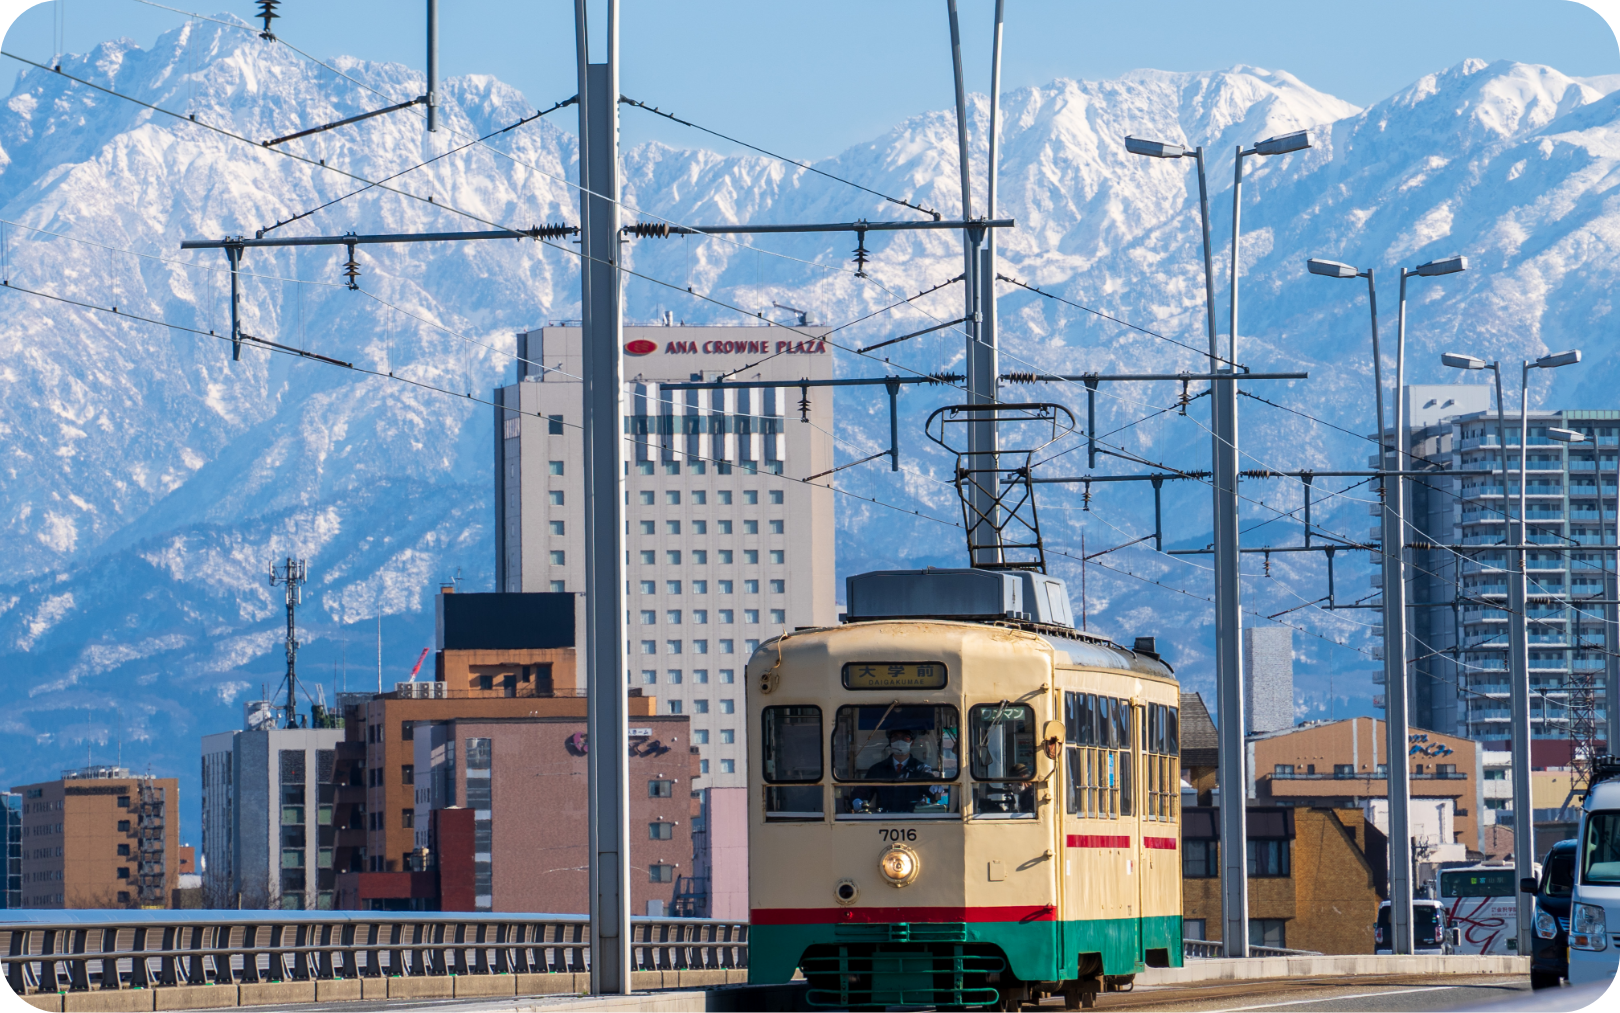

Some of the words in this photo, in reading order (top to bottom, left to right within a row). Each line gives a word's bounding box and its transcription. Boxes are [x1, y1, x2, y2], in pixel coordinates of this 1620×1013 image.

[666, 341, 698, 354] ANA
[703, 341, 769, 354] CROWNE
[777, 340, 826, 354] PLAZA
[859, 665, 934, 678] 大学前
[981, 708, 1025, 720] ワンマン
[879, 829, 917, 841] 7016
